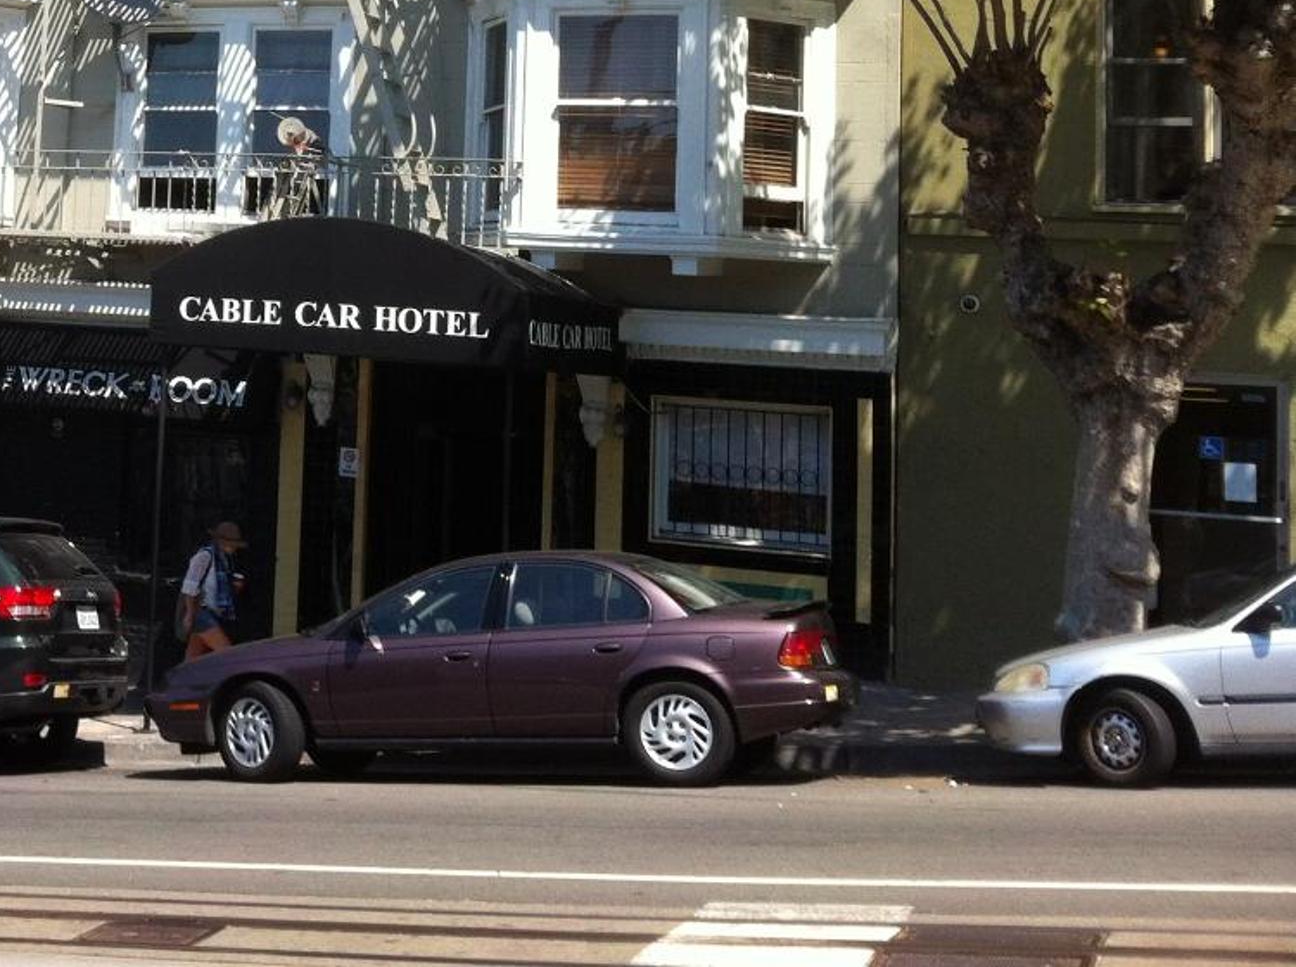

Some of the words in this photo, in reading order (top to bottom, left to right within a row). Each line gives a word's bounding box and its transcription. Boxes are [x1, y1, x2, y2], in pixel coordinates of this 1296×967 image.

[179, 295, 282, 326] CABLE
[294, 300, 362, 330] CAR
[373, 304, 490, 339] HOTEL
[529, 319, 561, 348] CABLE
[562, 323, 582, 350] CAR
[584, 325, 613, 353] HOTEL
[18, 364, 131, 400] WRECK
[148, 373, 248, 408] ROOM
